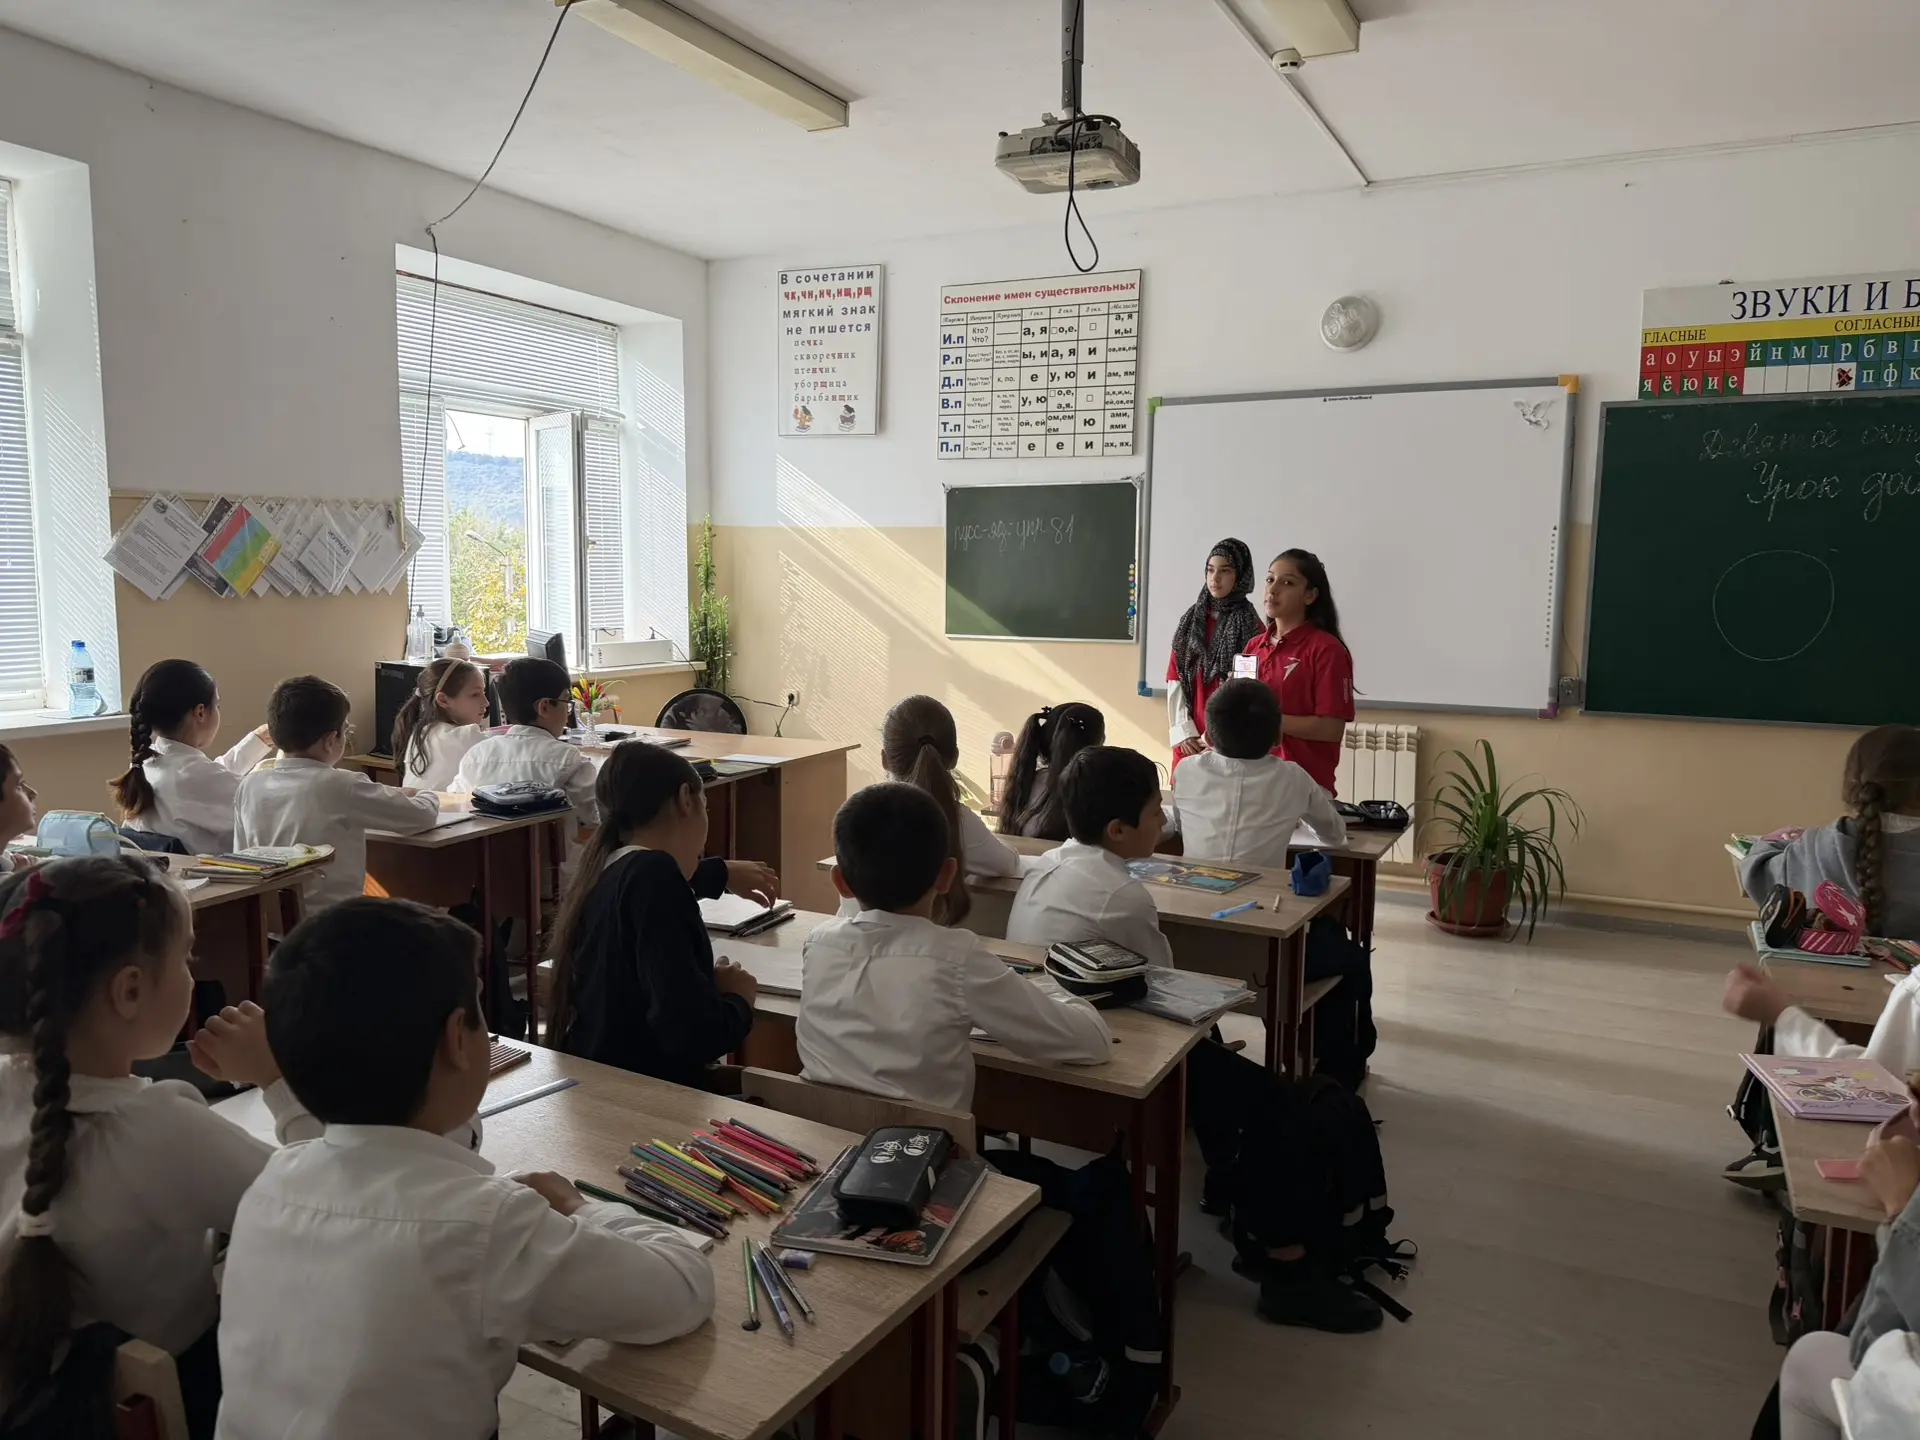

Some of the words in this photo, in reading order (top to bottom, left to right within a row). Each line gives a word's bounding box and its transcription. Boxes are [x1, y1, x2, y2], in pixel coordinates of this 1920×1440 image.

[781, 274, 788, 285] В
[795, 269, 874, 284] сочетании
[944, 293, 1001, 305] Склонение
[1004, 289, 1032, 300] имен
[1034, 282, 1136, 298] существительных
[1731, 284, 1852, 320] ЗВУКИ
[1863, 281, 1891, 311] И
[783, 305, 834, 319] мягкий
[841, 305, 876, 316] знак
[786, 326, 803, 336] не
[809, 322, 871, 335] пишется
[943, 334, 964, 345] И.п
[1643, 329, 1707, 344] ГЛАСНЫЕ
[794, 339, 824, 347] печка
[1088, 346, 1097, 355] и
[1646, 354, 1656, 366] а
[1666, 353, 1676, 364] о
[1688, 351, 1700, 368] у
[1707, 350, 1722, 362] ы
[1731, 349, 1740, 361] э
[1750, 344, 1761, 361] й
[1771, 346, 1783, 359] н
[1792, 345, 1806, 359] м
[1816, 345, 1828, 358] л
[1840, 342, 1852, 361] р
[1863, 339, 1876, 358] б
[1887, 340, 1898, 354] в
[794, 352, 856, 363] скворечник
[943, 354, 963, 365] Р.п
[794, 367, 837, 375] птенчик
[1065, 371, 1076, 379] ю
[1088, 371, 1096, 380] и
[941, 377, 963, 389] Д.п
[1030, 374, 1039, 382] е
[1642, 379, 1652, 392] я
[1663, 375, 1672, 392] ё
[1683, 377, 1698, 391] ю
[1707, 377, 1719, 390] и
[1728, 375, 1738, 388] е
[1862, 369, 1875, 383] п
[1883, 363, 1898, 387] ф
[794, 380, 847, 390] уборщица
[794, 393, 859, 404] барабанщик
[941, 398, 962, 409] В.п
[1036, 395, 1047, 403] ю
[941, 421, 961, 432] Т.п
[1084, 418, 1096, 427] ю
[940, 441, 961, 452] П.п
[1028, 443, 1036, 451] е
[1056, 442, 1064, 450] е
[1085, 441, 1094, 449] и
[1747, 461, 1842, 522] Урок
[328, 529, 350, 556] ЖУРНАЛ
